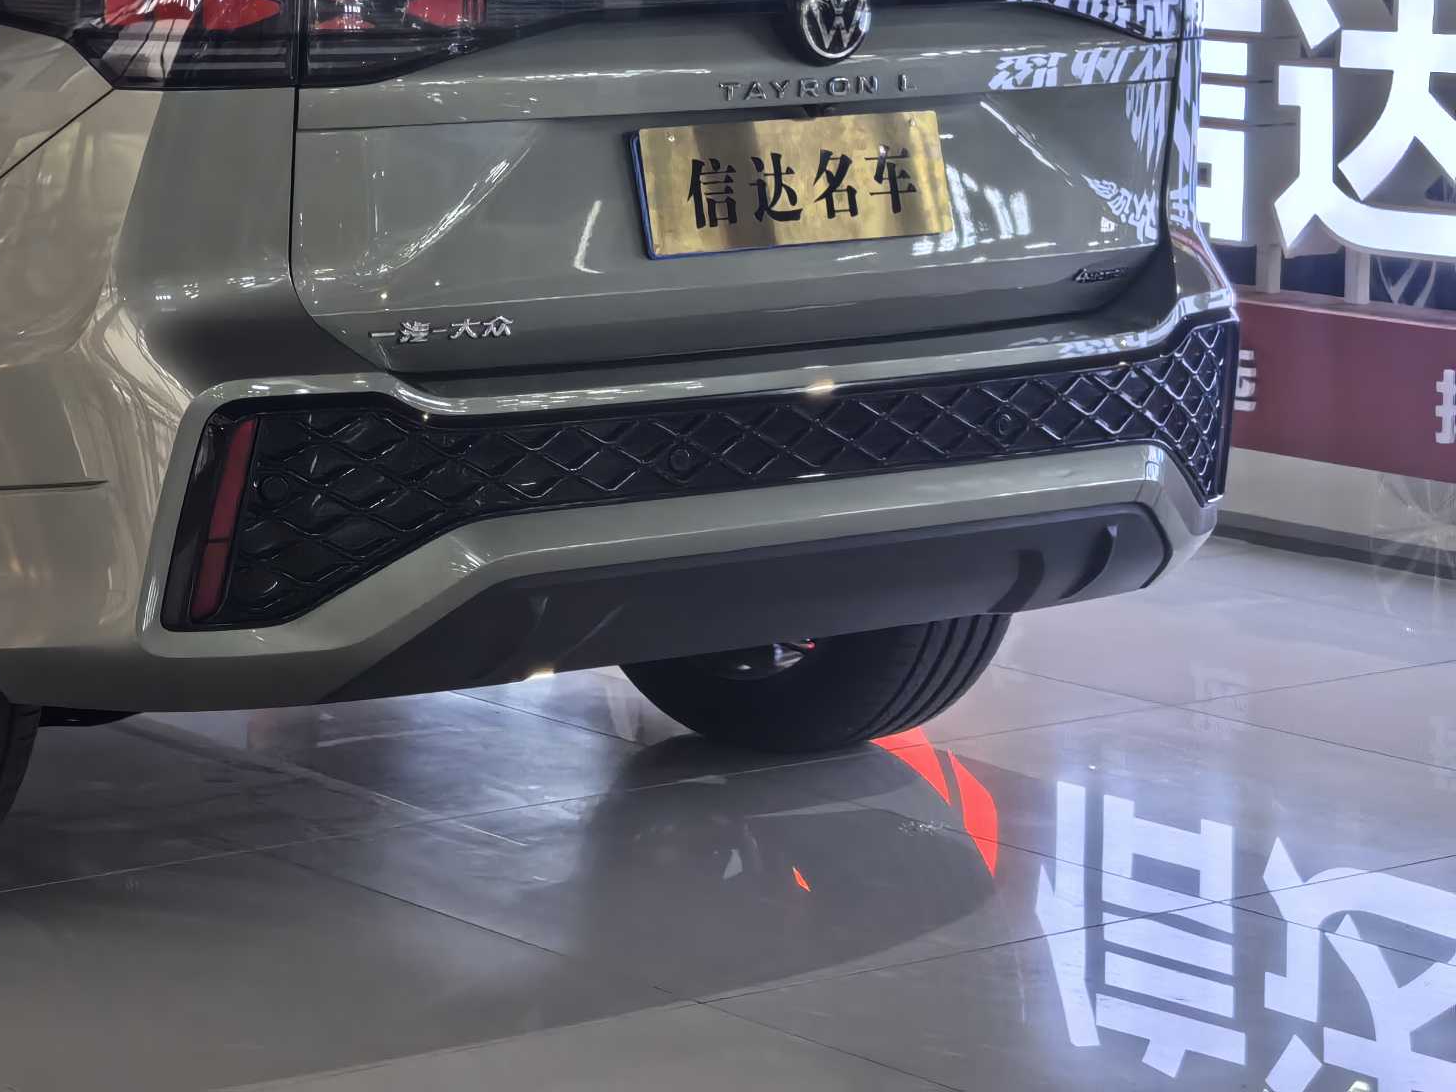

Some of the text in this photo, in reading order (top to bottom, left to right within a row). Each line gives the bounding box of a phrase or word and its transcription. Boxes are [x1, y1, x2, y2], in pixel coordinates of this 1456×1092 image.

[718, 73, 920, 101] TAYRON L
[687, 143, 918, 230] 信达名车
